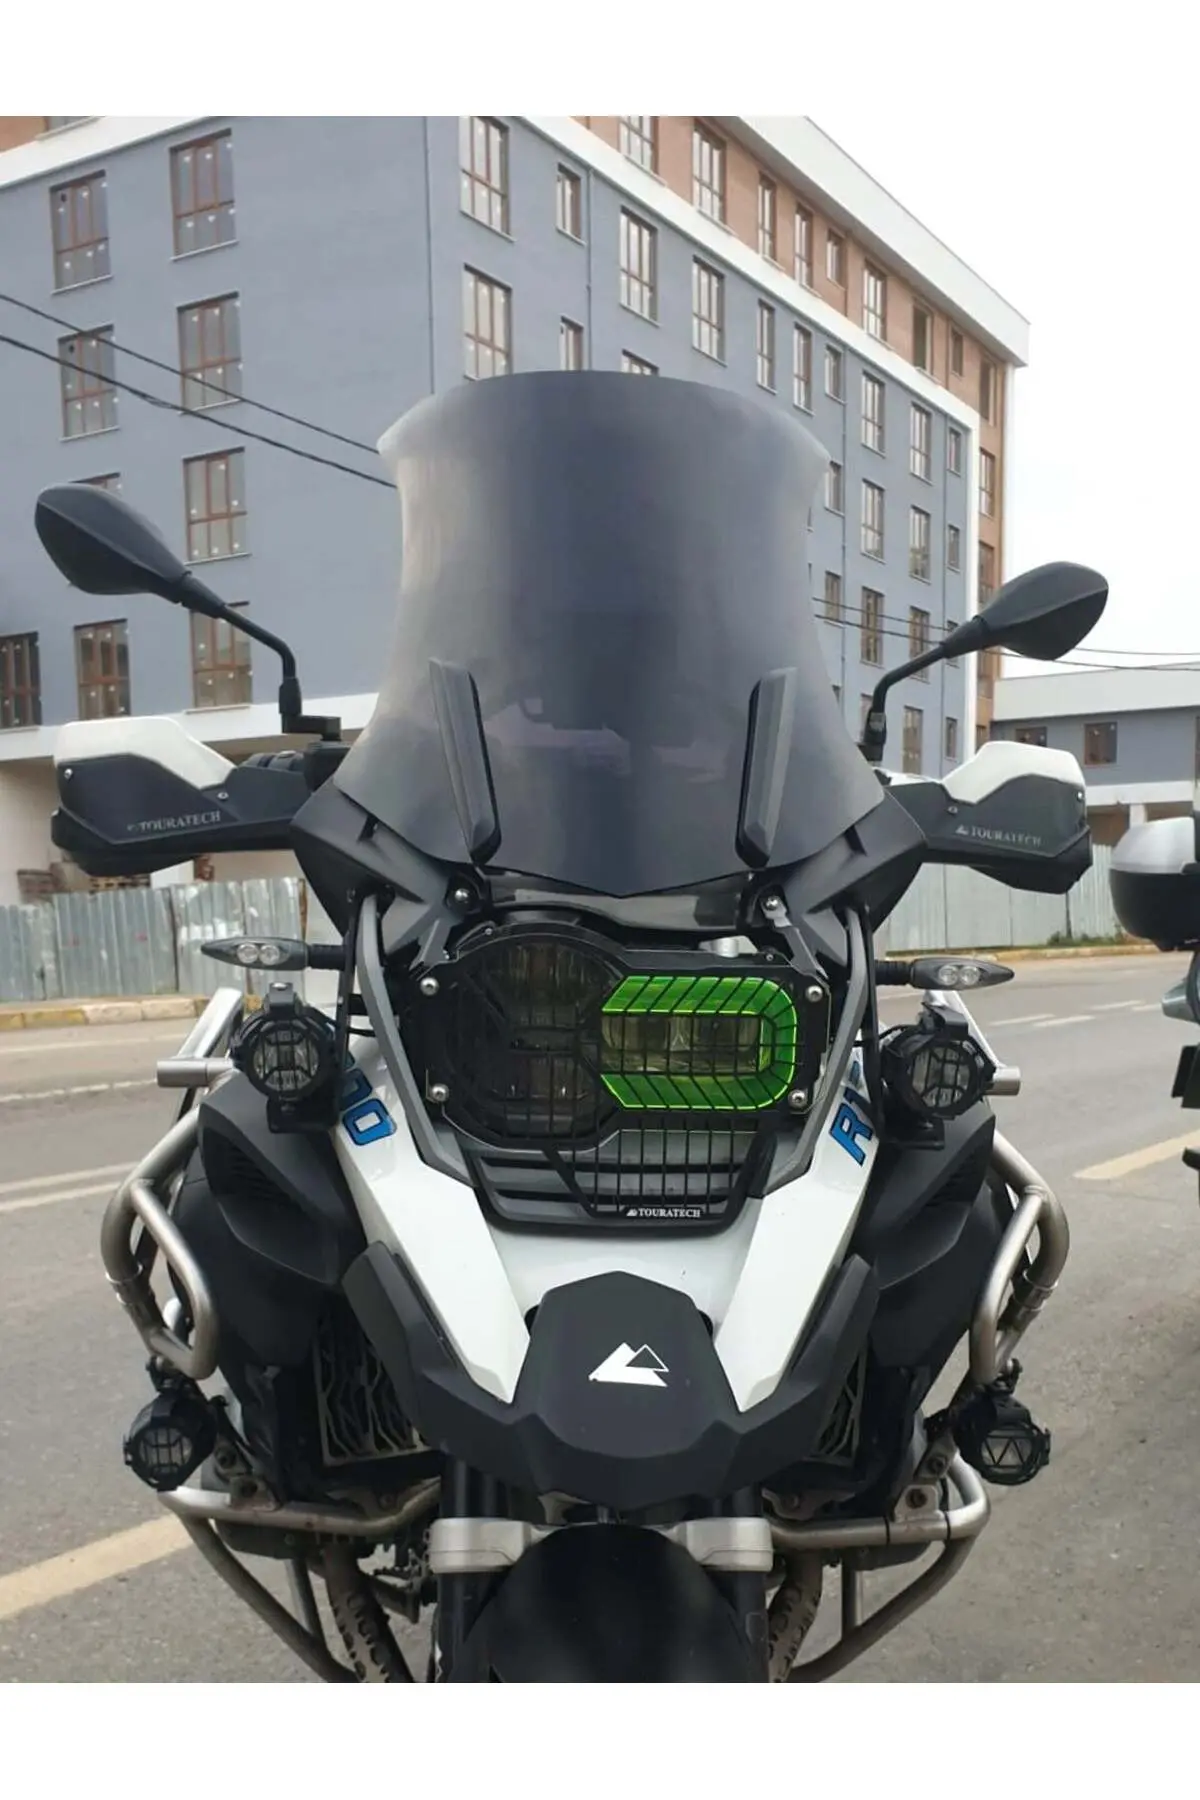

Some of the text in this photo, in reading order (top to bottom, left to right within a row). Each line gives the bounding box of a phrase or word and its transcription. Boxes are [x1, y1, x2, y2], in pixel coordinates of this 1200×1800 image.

[139, 810, 220, 831] TOURATECH
[971, 825, 1042, 847] TOURATECH
[638, 1207, 701, 1218] TOURATECH
